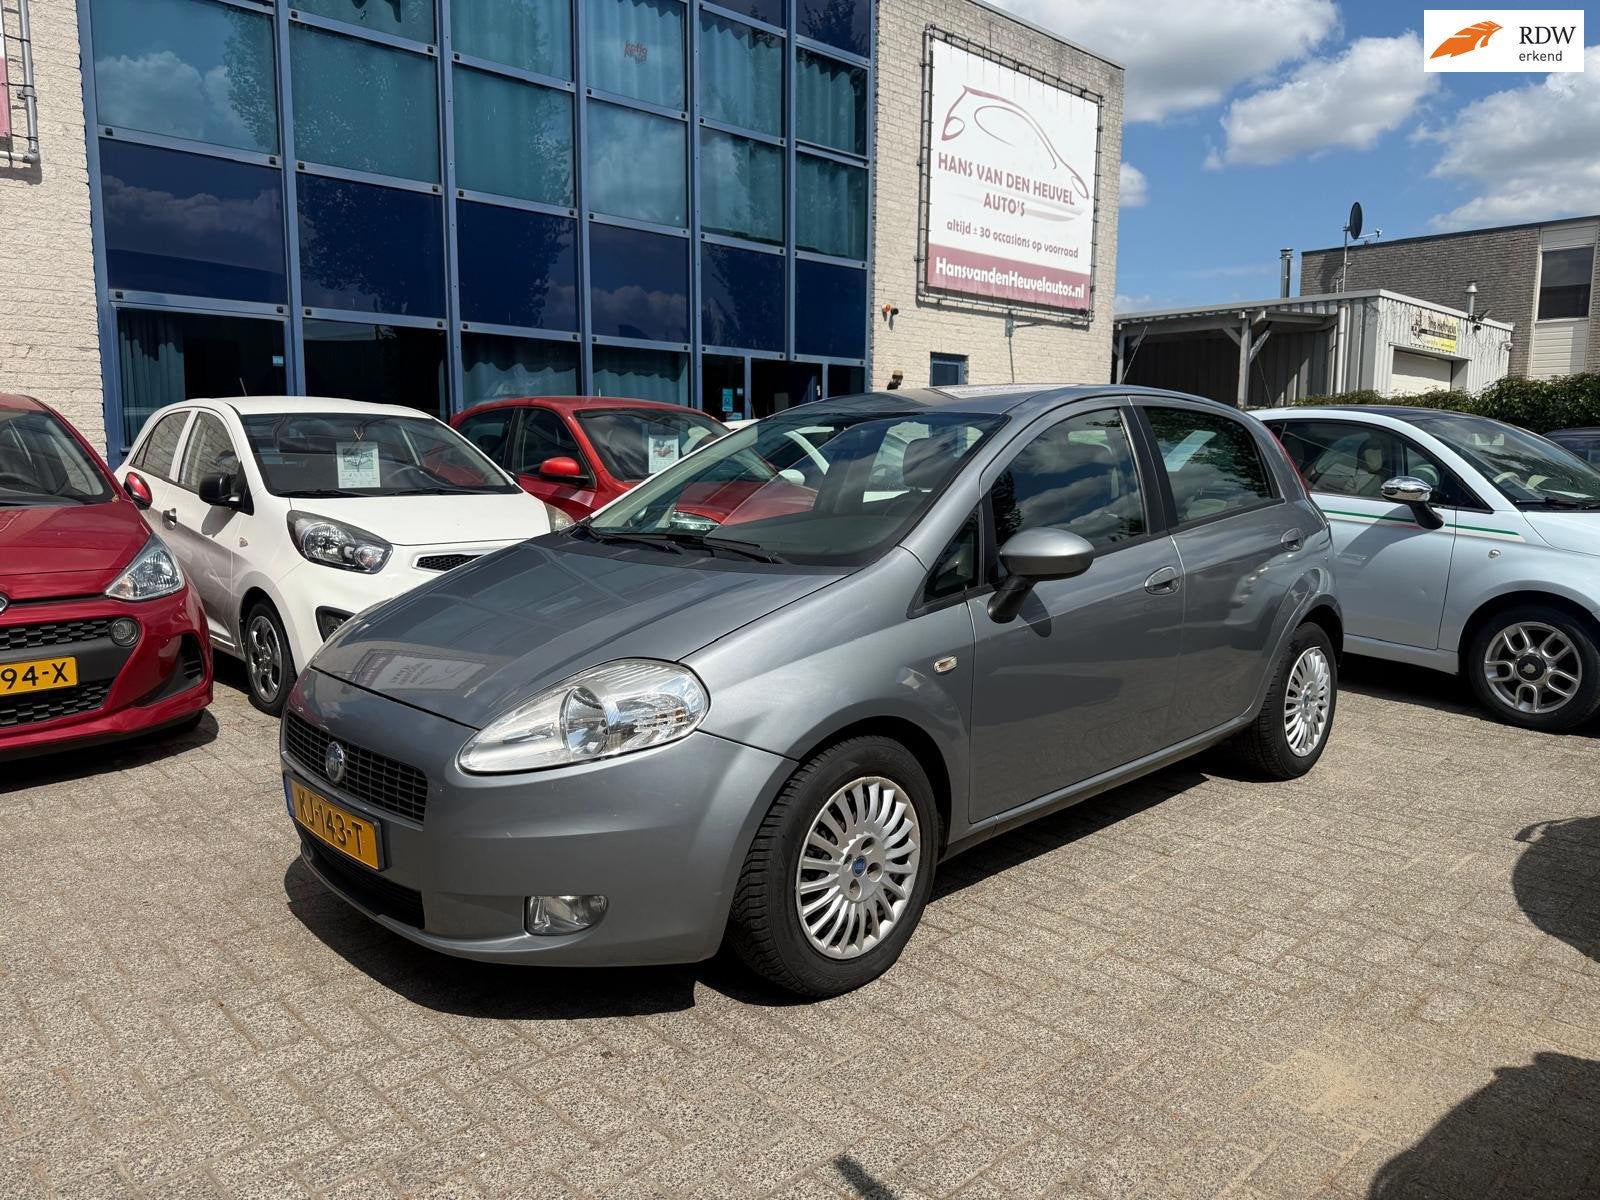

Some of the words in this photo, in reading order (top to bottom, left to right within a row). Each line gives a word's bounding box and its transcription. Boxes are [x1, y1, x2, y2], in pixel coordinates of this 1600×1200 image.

[938, 152, 973, 177] HANS
[976, 164, 1003, 186] VAN
[1006, 173, 1030, 193] DEN
[1033, 181, 1075, 205] HEUVEL
[983, 192, 1025, 216] AUTO'S
[946, 219, 971, 235] altijd
[979, 226, 991, 239] 30
[993, 231, 1030, 248] occasions
[1032, 240, 1042, 253] op
[1044, 244, 1079, 259] voorraad
[935, 257, 1085, 298] HansvandenHeuvelautos.nl
[0, 662, 69, 690] 94-X
